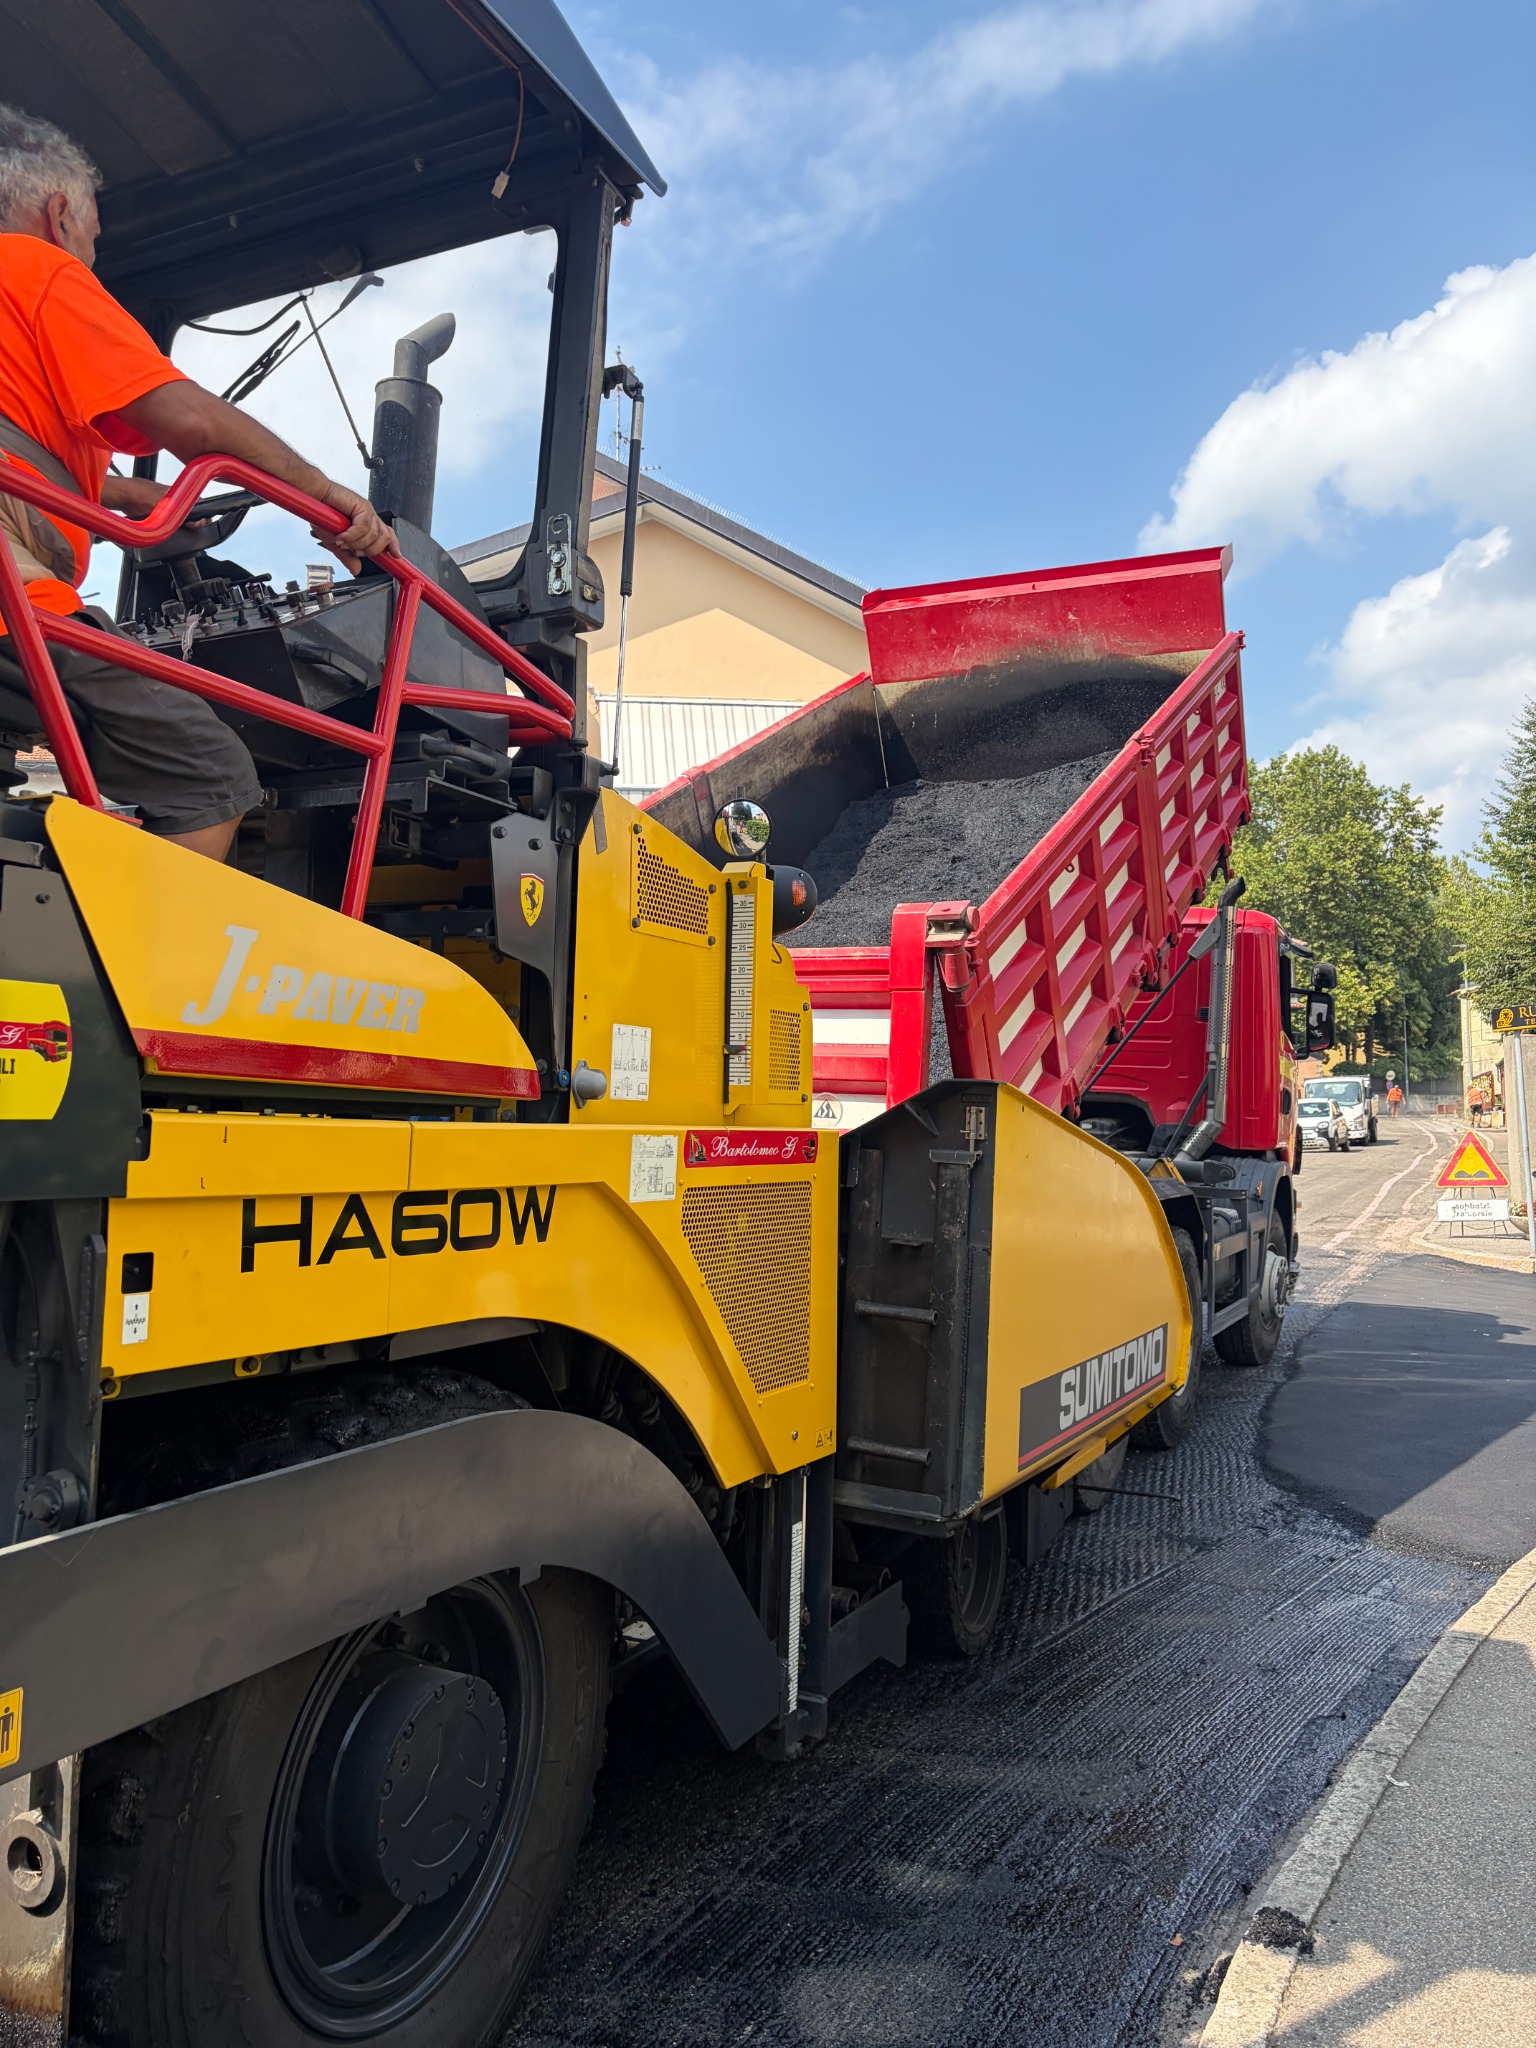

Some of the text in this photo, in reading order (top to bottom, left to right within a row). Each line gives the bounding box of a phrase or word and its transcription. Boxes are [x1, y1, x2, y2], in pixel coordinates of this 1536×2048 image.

[737, 988, 746, 996] 15
[737, 1010, 745, 1018] 10
[710, 1136, 780, 1158] Bartolomeo
[240, 1185, 557, 1273] HA60W
[1059, 1327, 1164, 1431] SUMITOMO
